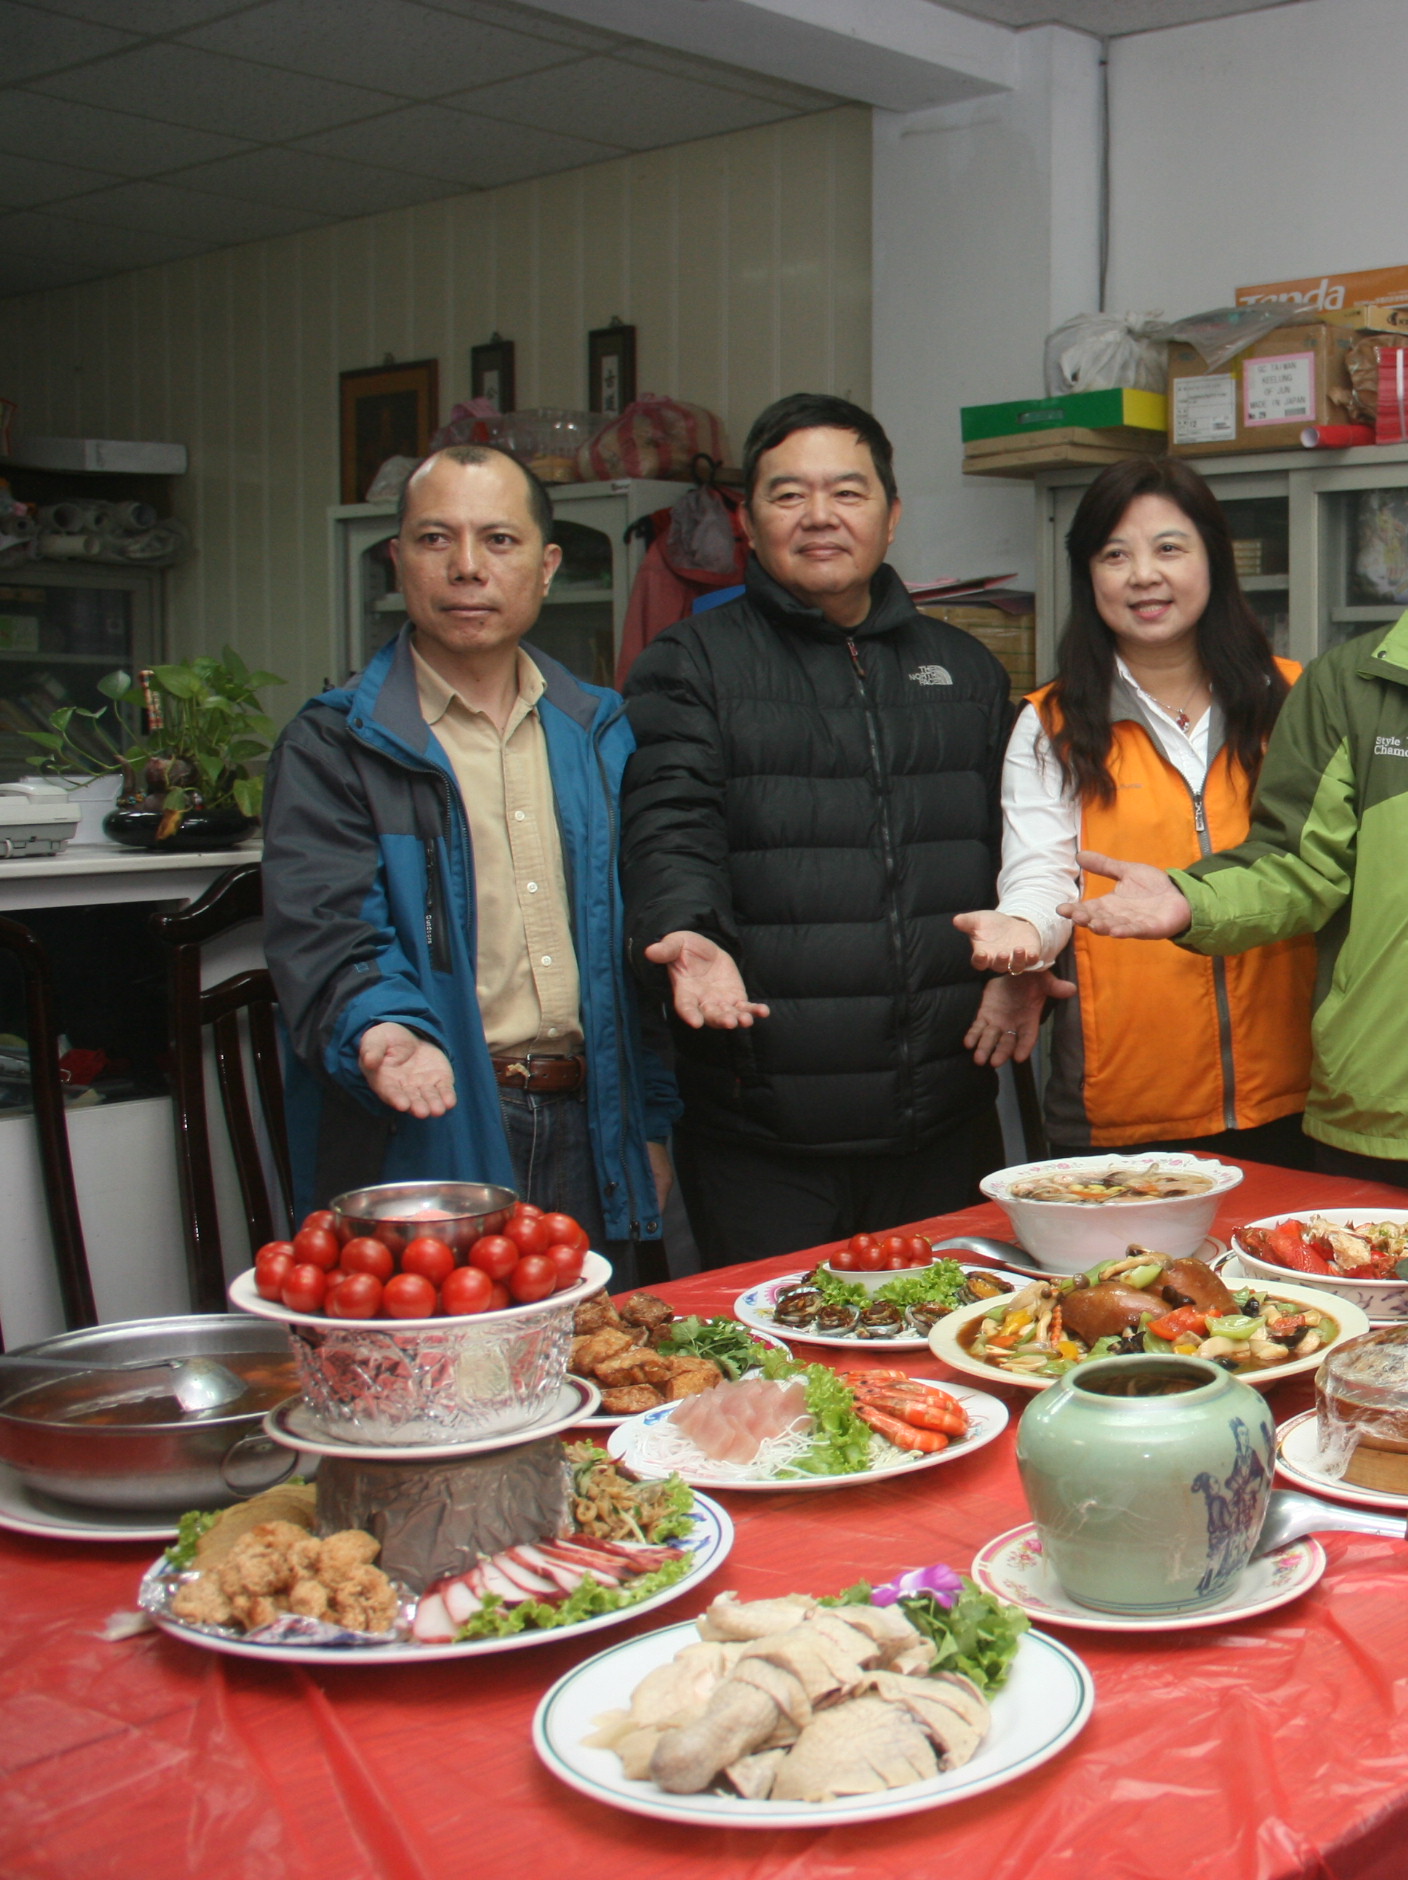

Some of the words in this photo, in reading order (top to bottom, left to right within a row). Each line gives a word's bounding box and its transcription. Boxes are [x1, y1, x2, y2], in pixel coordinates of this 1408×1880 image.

[1262, 375, 1293, 384] KEELUNG
[1250, 400, 1266, 409] MADE
[1285, 397, 1306, 406] JAPAN
[1375, 736, 1400, 747] Style
